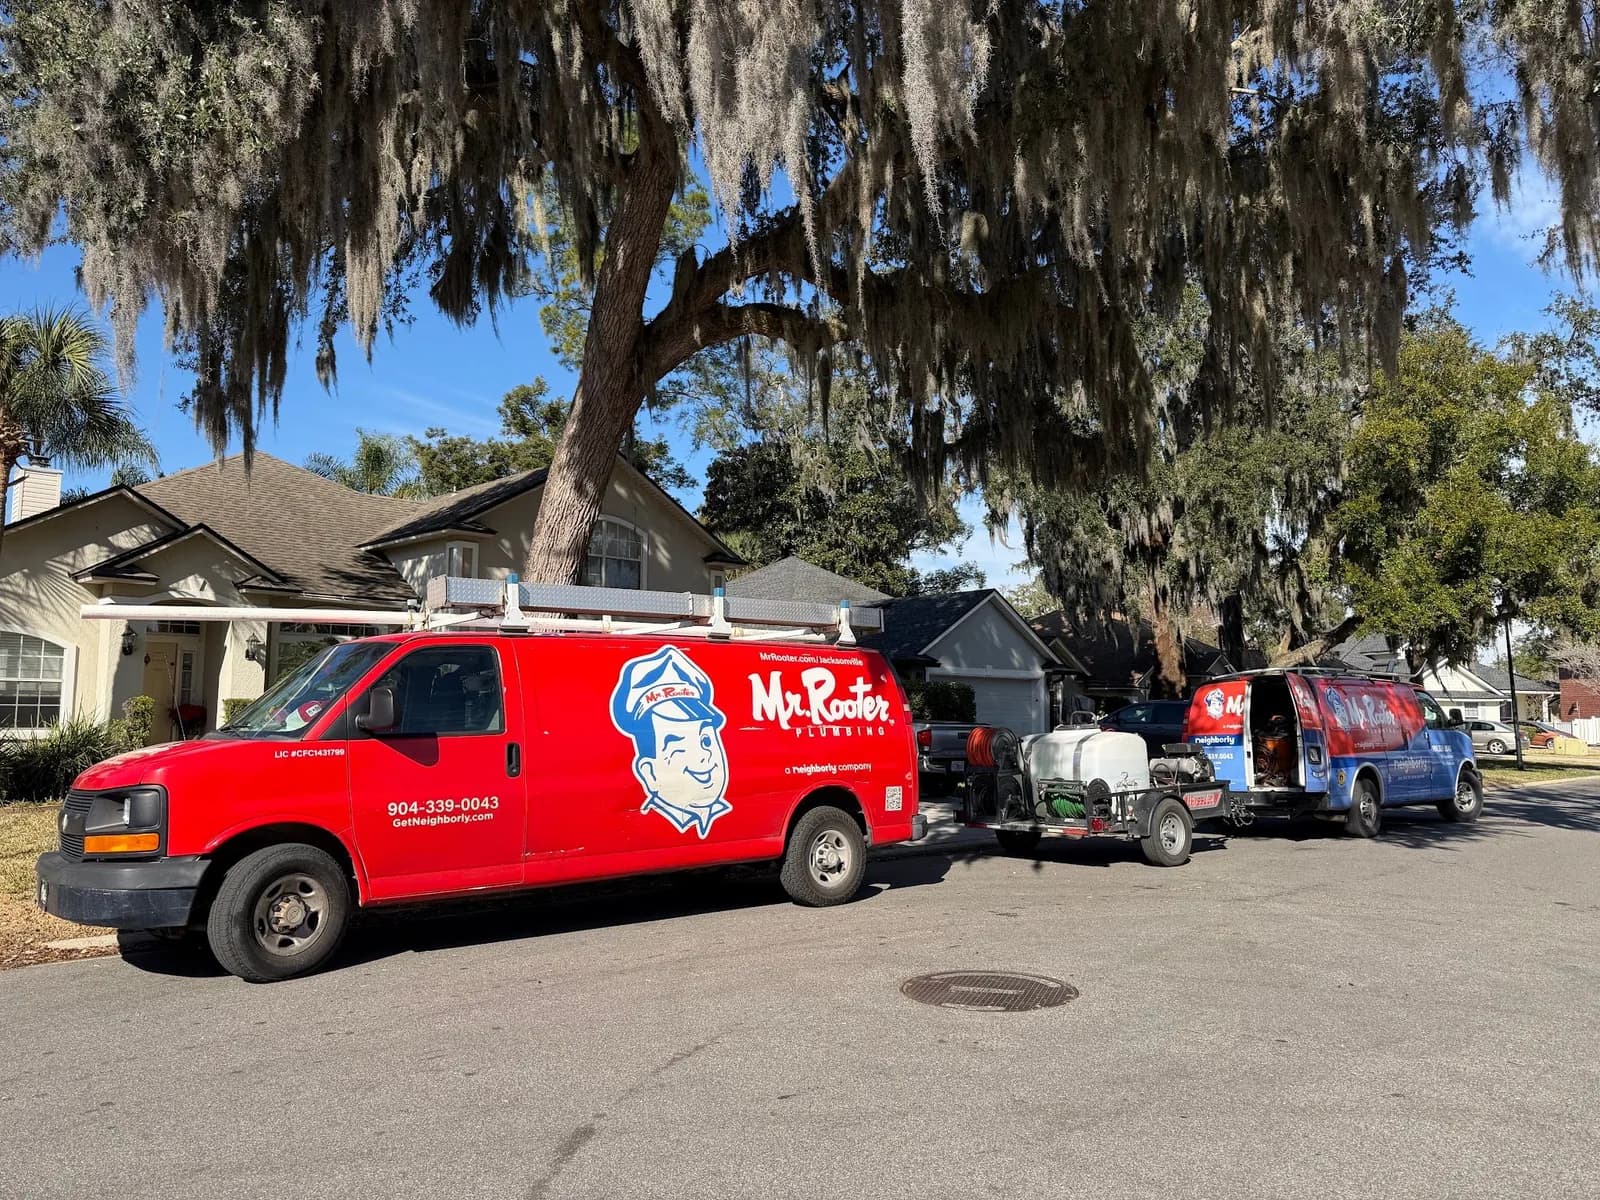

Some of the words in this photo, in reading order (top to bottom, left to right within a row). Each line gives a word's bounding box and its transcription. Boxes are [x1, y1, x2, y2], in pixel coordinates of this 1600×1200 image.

[796, 727, 885, 737] PLUMBING
[274, 750, 289, 758] LIC
[793, 764, 836, 775] neighborly
[838, 763, 872, 773] company
[387, 796, 499, 816] 904-339-0043
[392, 813, 494, 828] GetNeighborly.com
